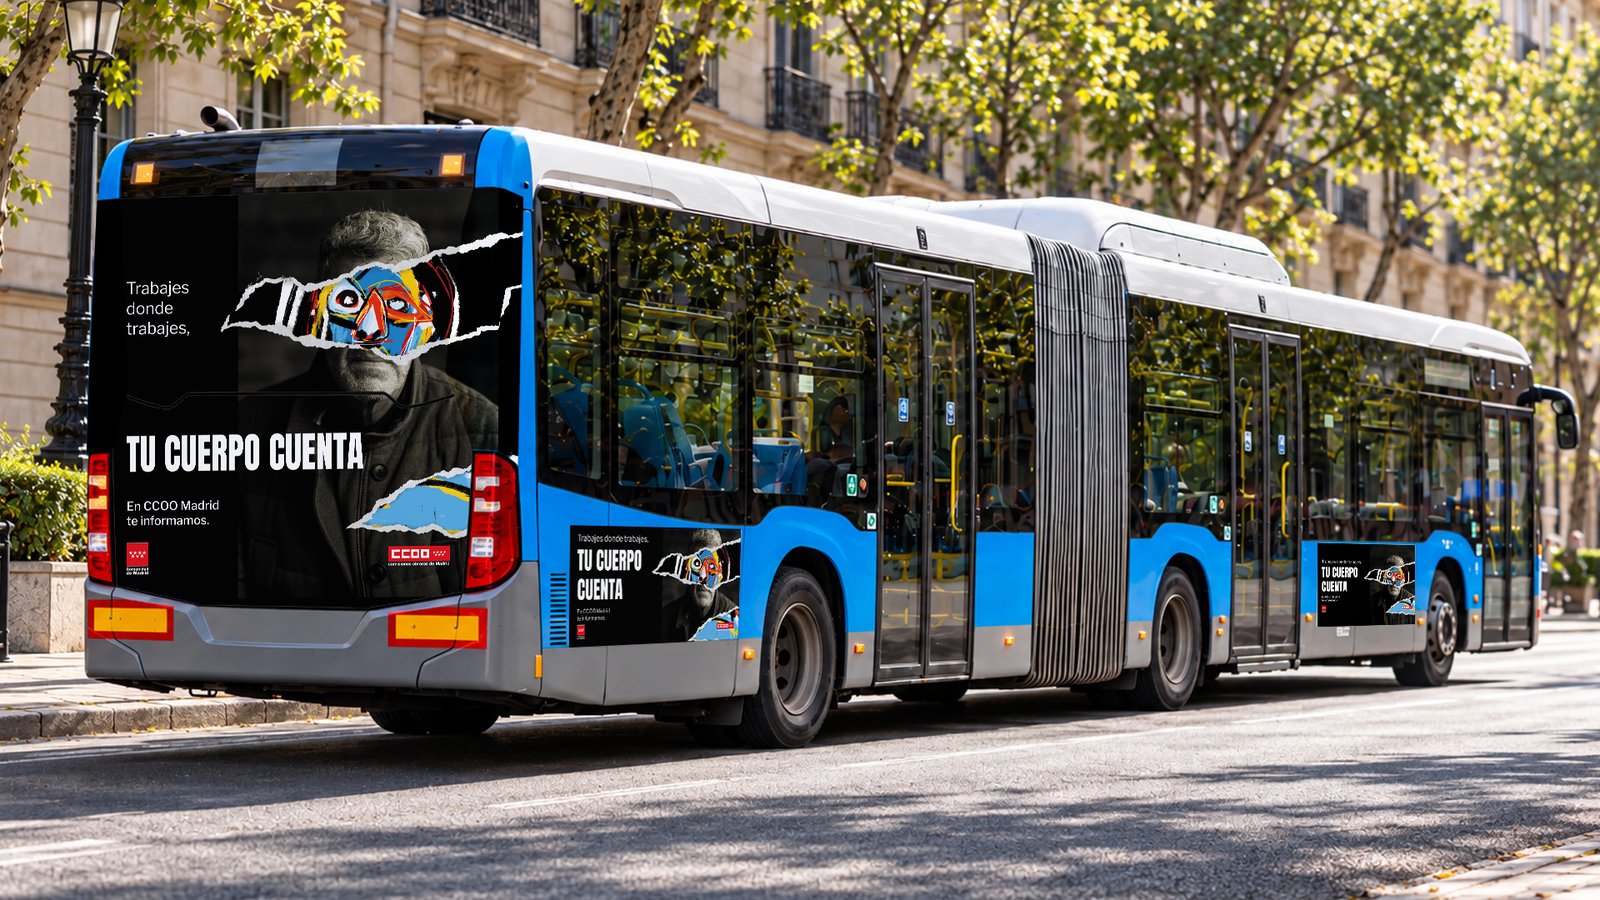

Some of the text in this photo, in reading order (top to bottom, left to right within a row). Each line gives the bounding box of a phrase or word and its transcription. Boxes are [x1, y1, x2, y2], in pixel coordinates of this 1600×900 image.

[126, 281, 190, 298] Trabajes
[126, 300, 174, 316] donde
[126, 321, 190, 338] trabajes,
[126, 432, 365, 473] TU CUERPO CUENTA
[126, 499, 220, 512] En CCOO Madrid
[126, 515, 210, 527] te informamos.
[578, 533, 604, 544] Trabajes
[604, 535, 624, 543] donde
[391, 548, 430, 559] CCOO
[577, 549, 642, 572] TU CUERPO
[1321, 566, 1358, 578] TU CUERPO
[577, 578, 623, 601] CUENTA
[1321, 580, 1348, 592] CUENTA
